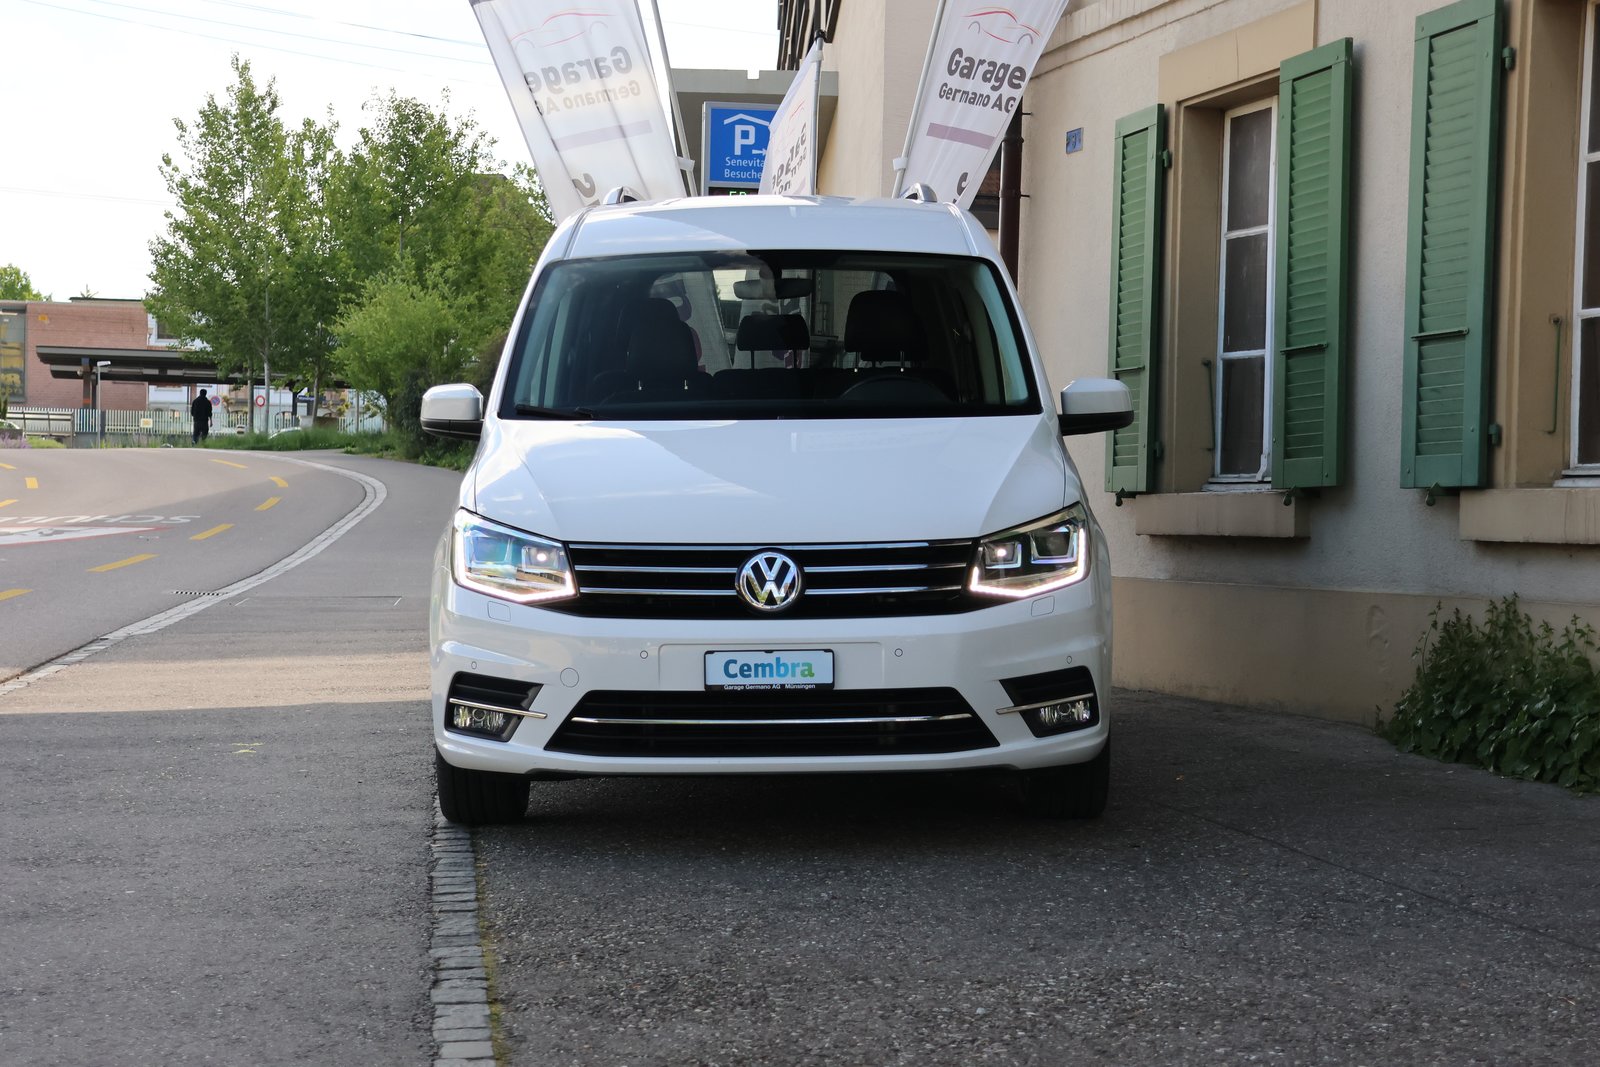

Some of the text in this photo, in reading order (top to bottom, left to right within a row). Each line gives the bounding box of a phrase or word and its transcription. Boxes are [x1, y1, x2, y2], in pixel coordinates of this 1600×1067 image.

[947, 47, 1027, 92] Garage
[938, 82, 1017, 114] Germano AG
[734, 124, 756, 156] P
[724, 168, 762, 179] Besuche
[725, 156, 765, 168] Senevita
[723, 656, 815, 679] Cembra
